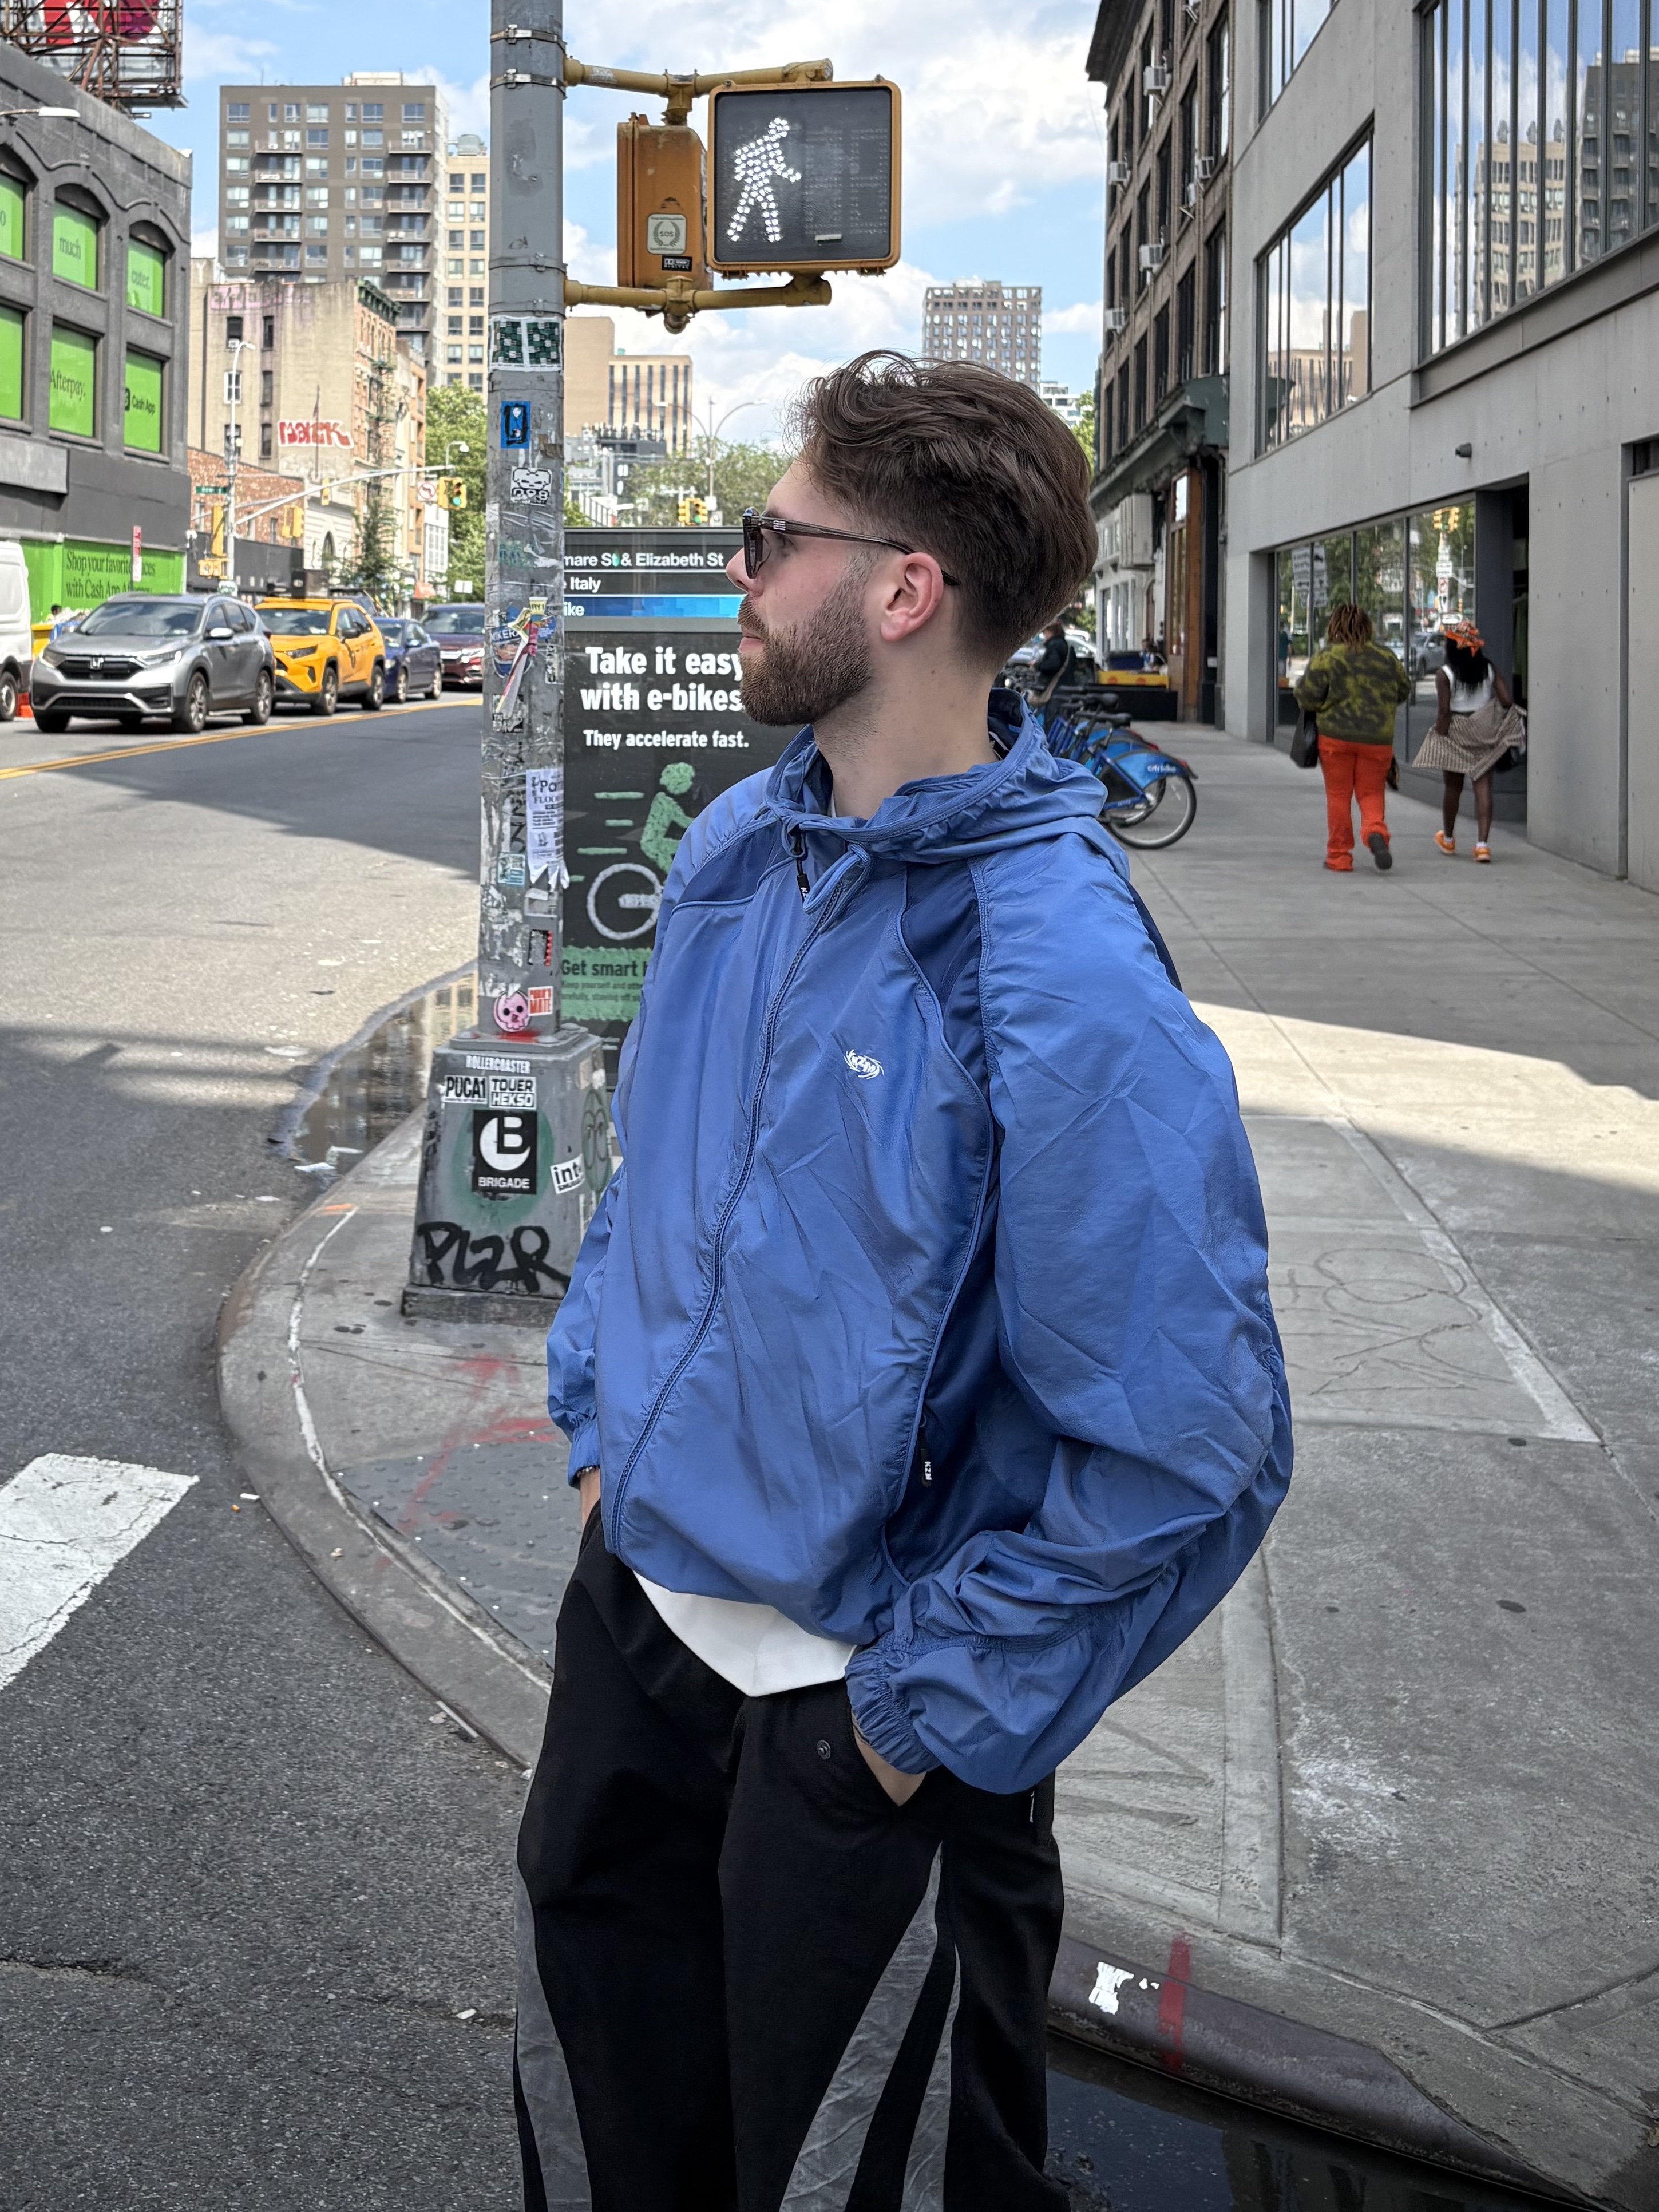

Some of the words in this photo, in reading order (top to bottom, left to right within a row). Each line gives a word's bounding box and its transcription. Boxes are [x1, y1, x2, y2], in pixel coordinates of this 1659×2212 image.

[59, 237, 81, 260] much
[132, 395, 144, 411] Cash
[145, 400, 155, 416] App
[66, 551, 86, 576] Shop
[88, 557, 104, 576] your
[564, 556, 598, 567] mare
[601, 553, 620, 567] St
[621, 553, 632, 567] &
[636, 553, 704, 567] Elizabeth
[707, 553, 724, 567] St
[66, 578, 84, 598] with
[85, 579, 104, 599] Cash
[570, 576, 601, 593] Italy
[564, 602, 584, 616] ike
[585, 646, 647, 675] Take
[655, 646, 676, 675] it
[686, 652, 743, 682] easy
[580, 682, 640, 710] with
[583, 730, 621, 750] They
[625, 730, 708, 747] accelerate
[712, 730, 749, 748] fast.
[561, 959, 587, 976] Get
[592, 961, 638, 977] smart
[478, 1176, 530, 1189] BRIGADE
